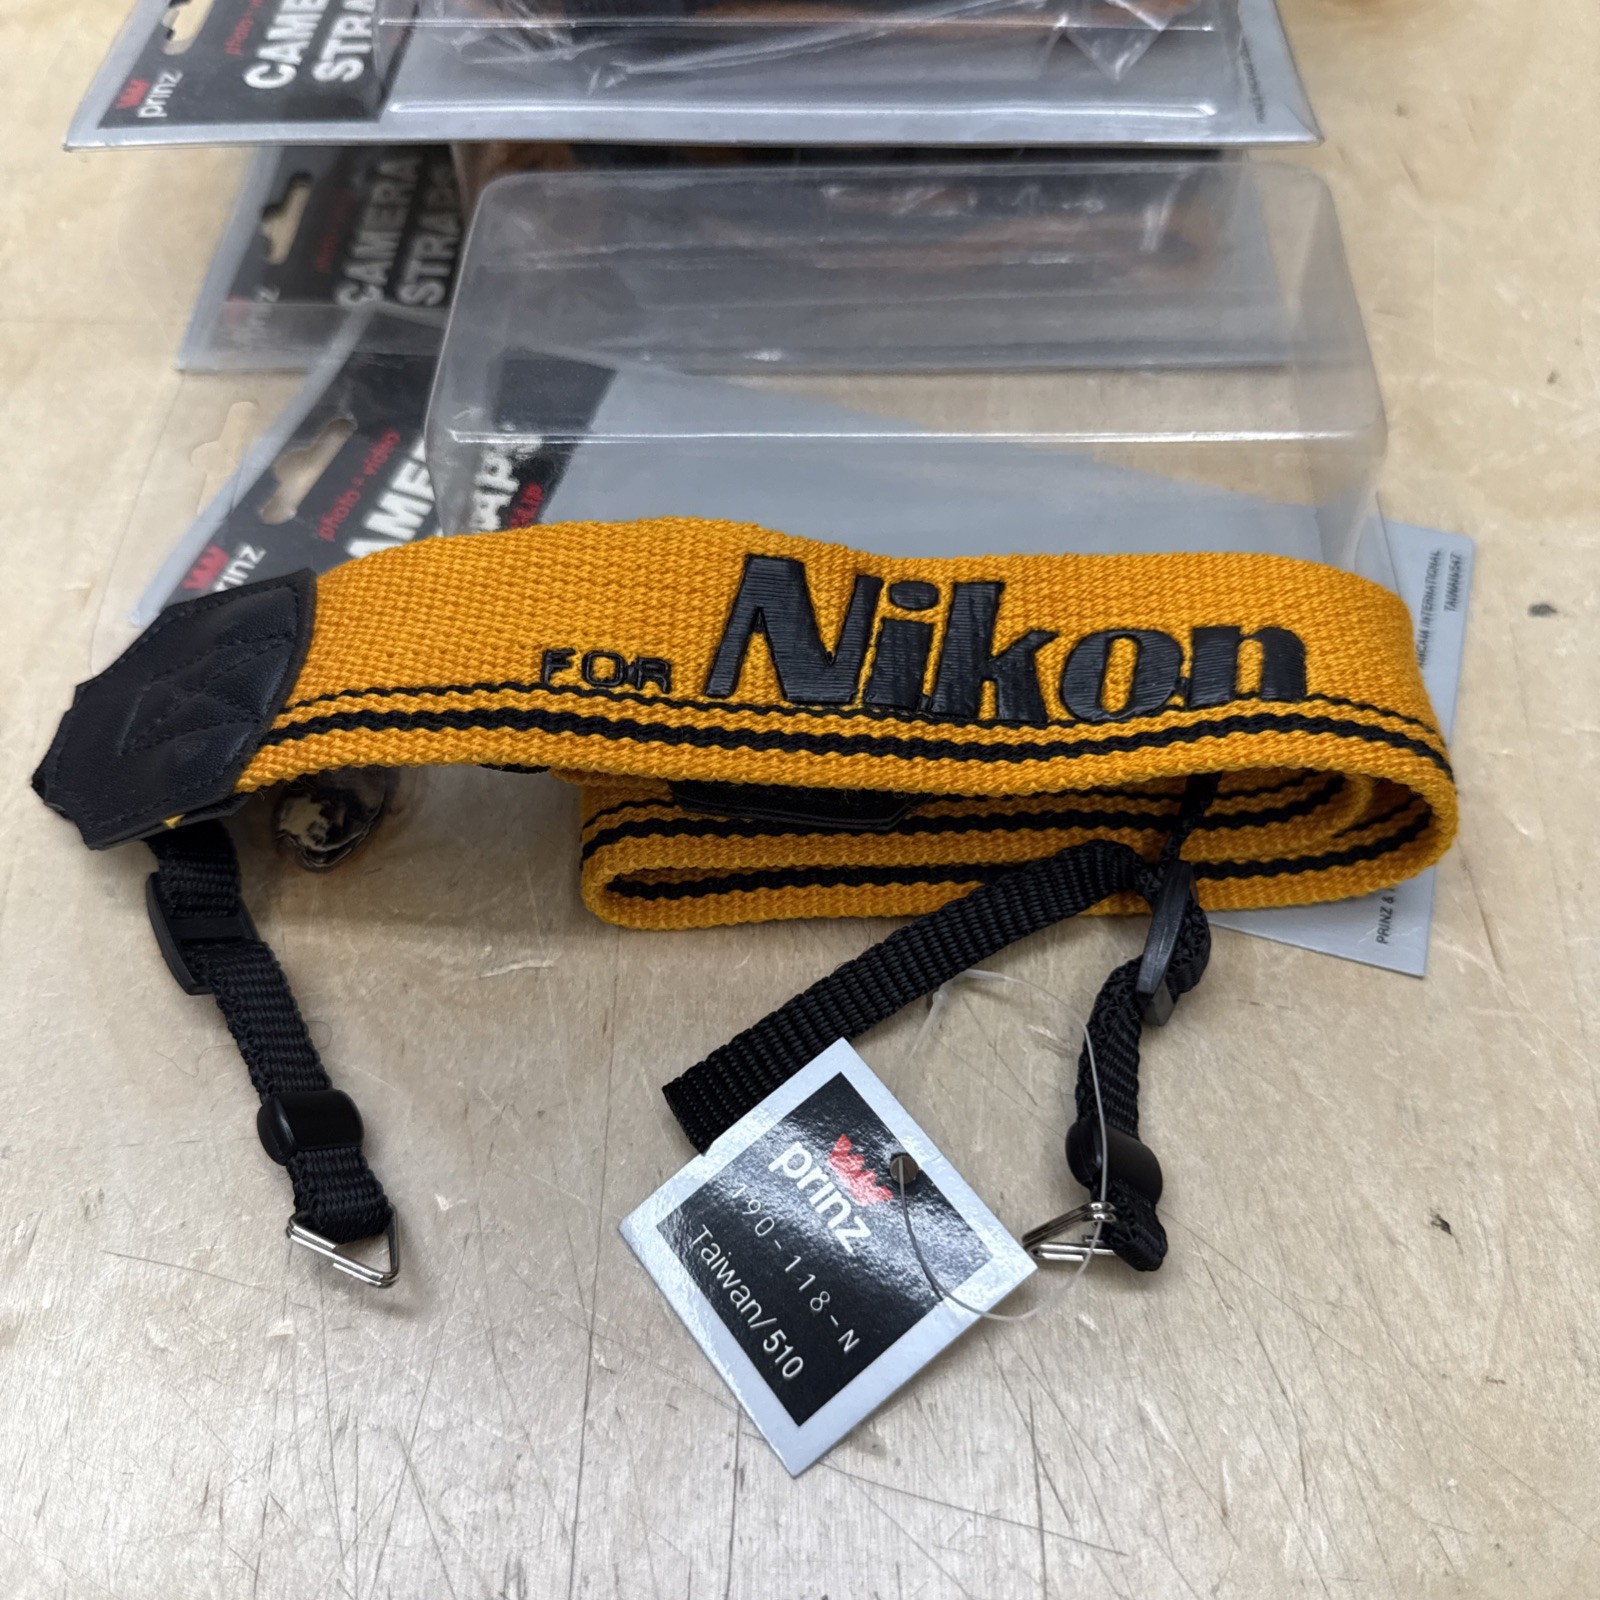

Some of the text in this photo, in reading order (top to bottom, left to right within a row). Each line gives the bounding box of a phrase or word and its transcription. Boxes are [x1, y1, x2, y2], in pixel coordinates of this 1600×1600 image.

[137, 71, 183, 118] prinz
[336, 156, 423, 306] CAMERA
[215, 544, 267, 592] inz
[540, 553, 1308, 722] FOR Nikon
[1376, 906, 1393, 945] PRINZ
[768, 1141, 871, 1254] prinz
[732, 1184, 860, 1353] 190-118-N
